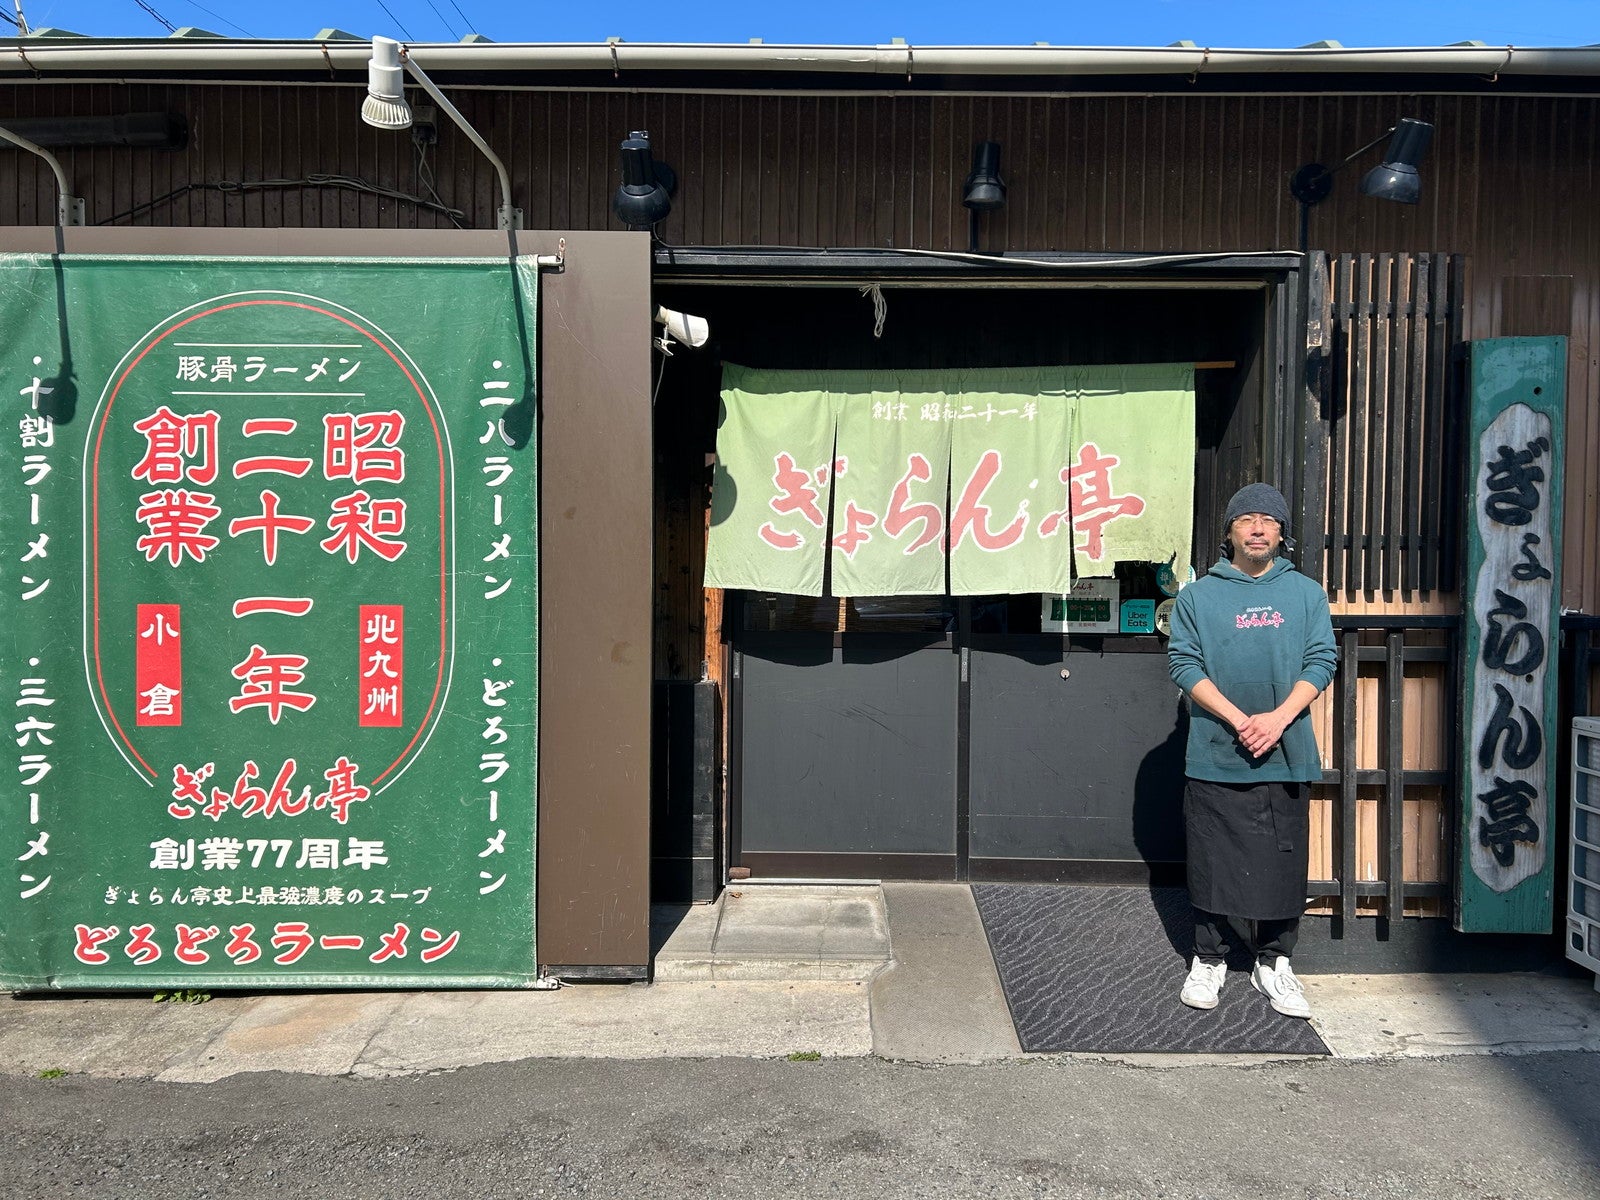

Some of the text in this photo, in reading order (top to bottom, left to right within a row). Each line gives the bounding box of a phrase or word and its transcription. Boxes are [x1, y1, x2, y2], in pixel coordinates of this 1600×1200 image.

[175, 355, 361, 383] 豚骨ラーメン
[872, 401, 1038, 422] 創業 昭和二十一年
[130, 405, 222, 569] 創業
[319, 409, 408, 565] 昭和
[758, 440, 1146, 563] ぎょらん亭
[228, 417, 317, 726] 二十一年
[1127, 611, 1149, 619] Uber
[139, 612, 180, 717] 小倉
[362, 613, 399, 717] 北九州
[1479, 436, 1552, 869] ぎょらん亭
[167, 755, 372, 825] ぎょらん亭
[104, 885, 433, 906] ぎょらん亭史上最強濃度のスープ
[149, 836, 389, 871] 創業77周年
[73, 921, 461, 966] どろどろラーメン
